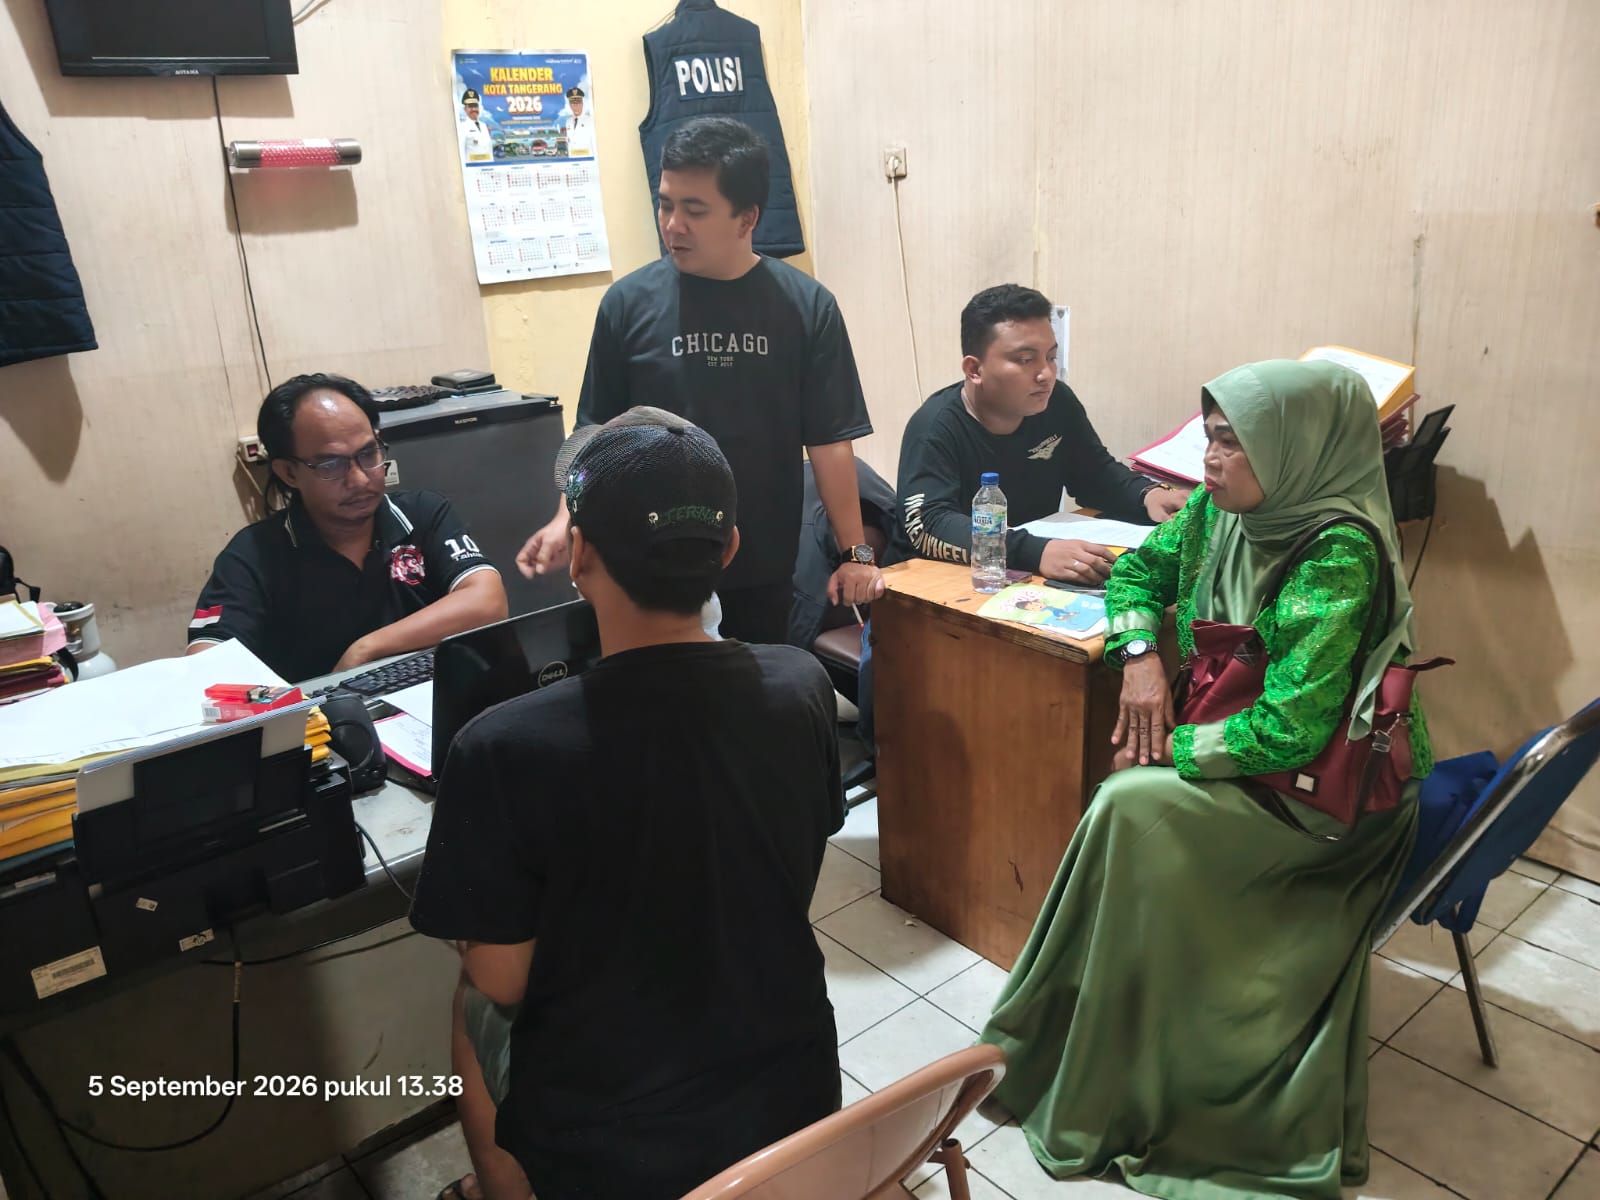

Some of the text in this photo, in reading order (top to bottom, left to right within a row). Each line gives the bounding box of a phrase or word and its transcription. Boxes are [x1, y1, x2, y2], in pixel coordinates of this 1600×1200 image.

[490, 67, 554, 82] KALENDER
[674, 56, 744, 96] POLISI
[483, 82, 563, 96] KOTA TANGERANG
[506, 96, 542, 114] 2026
[671, 332, 769, 357] CHICAGO
[444, 534, 480, 558] 10
[541, 669, 564, 681] DELL
